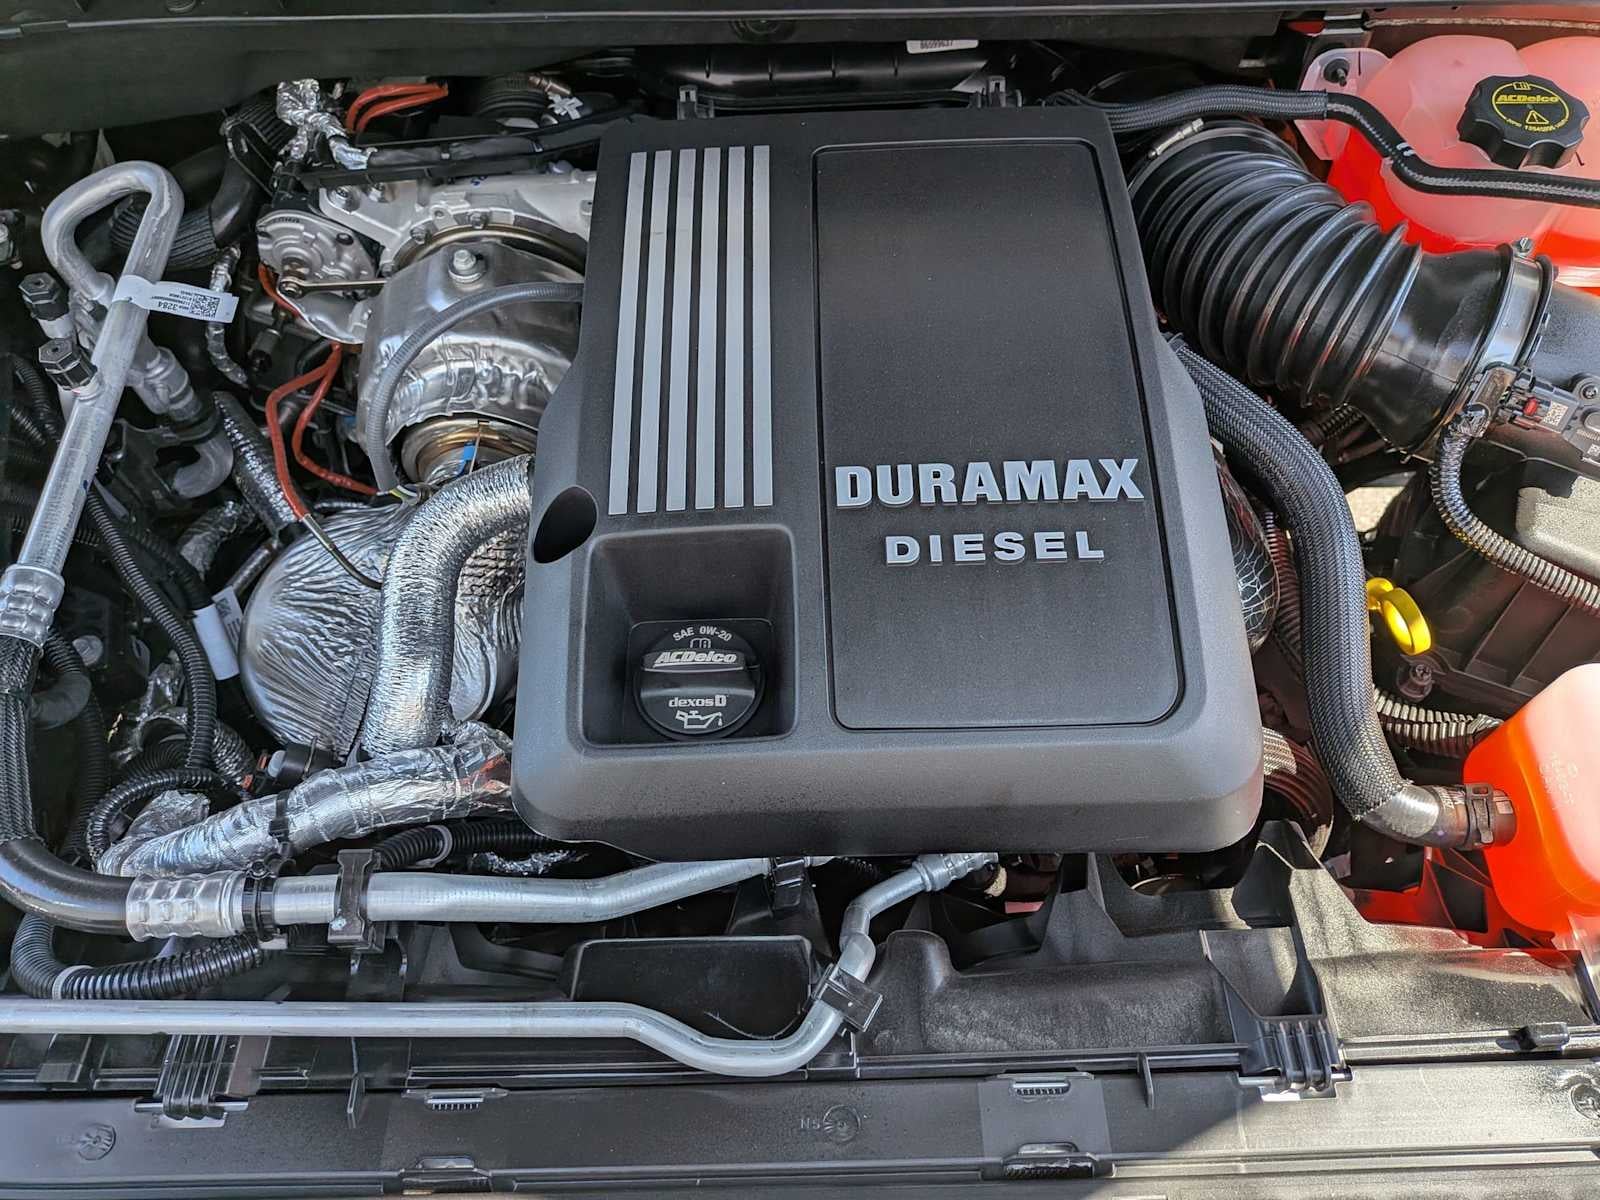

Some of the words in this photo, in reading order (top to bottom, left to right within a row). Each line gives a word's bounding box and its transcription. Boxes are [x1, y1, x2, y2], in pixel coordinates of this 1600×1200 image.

[835, 459, 1144, 507] DURAMAX
[885, 531, 1105, 566] DIESEL
[672, 626, 695, 641] SAE
[699, 625, 733, 642] 0W-20
[654, 651, 738, 664] ACDelco
